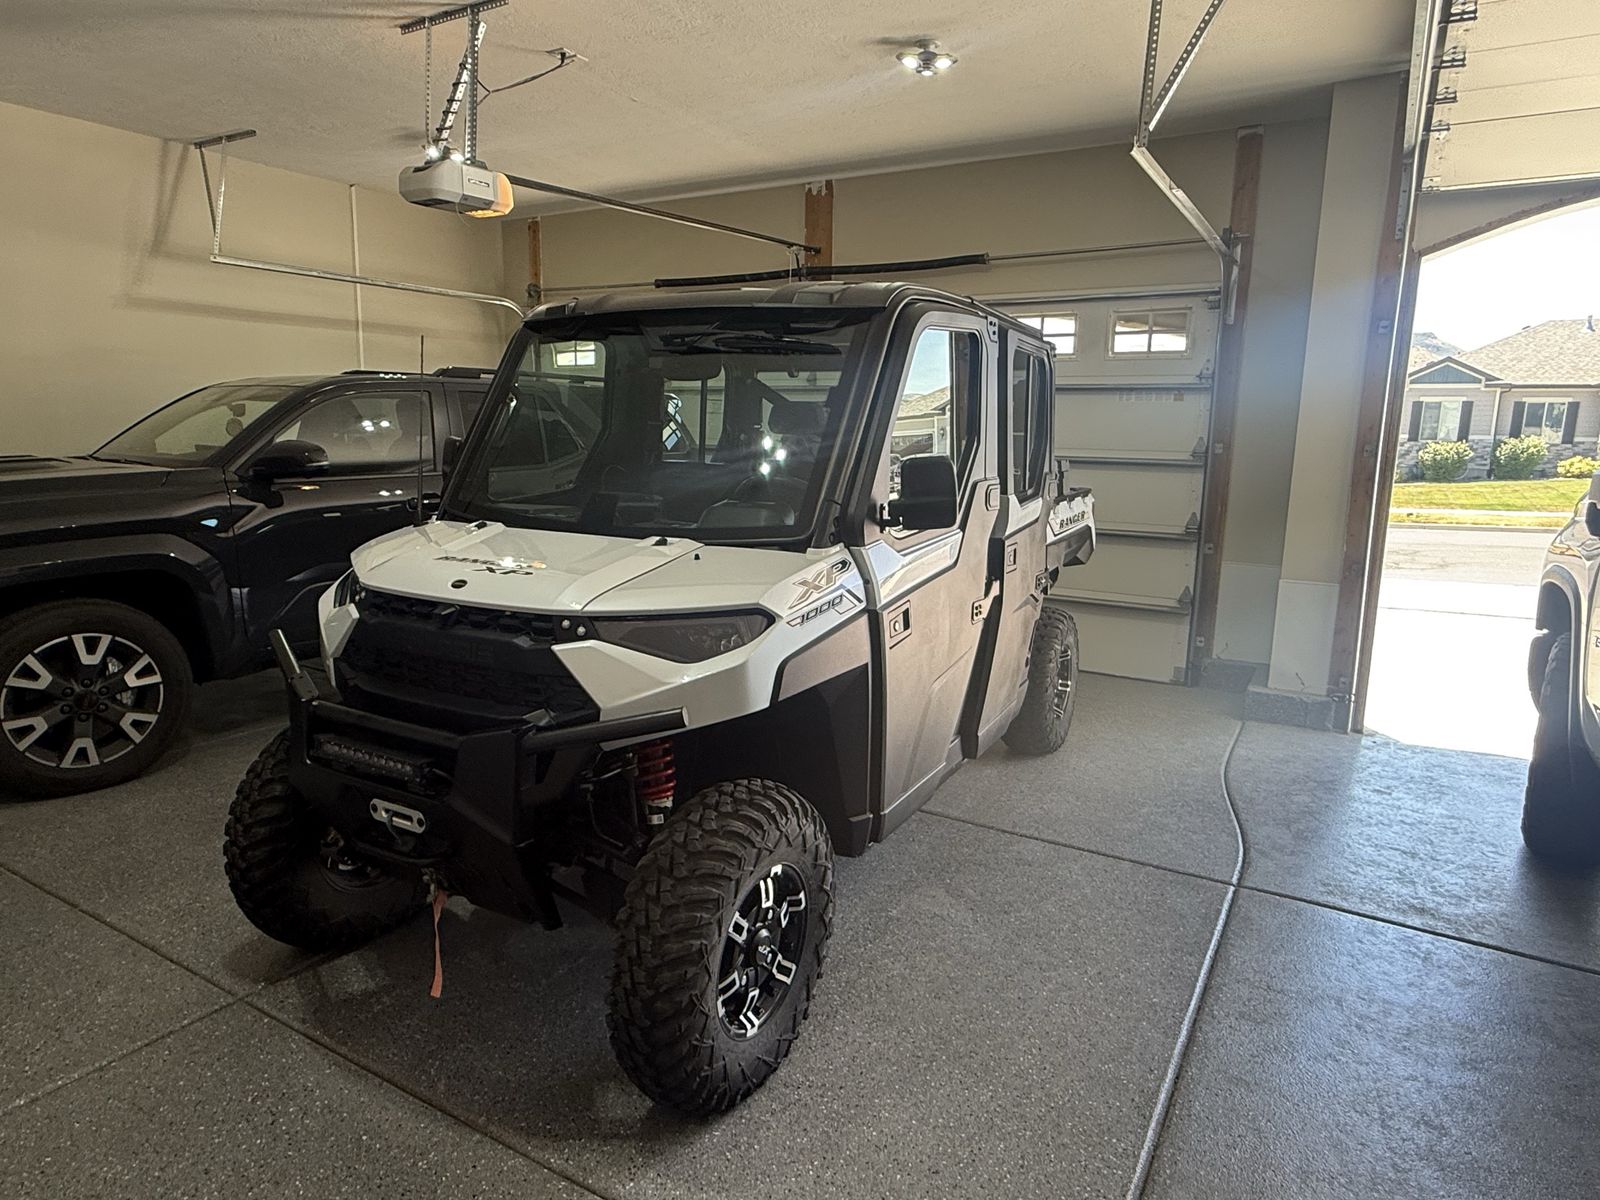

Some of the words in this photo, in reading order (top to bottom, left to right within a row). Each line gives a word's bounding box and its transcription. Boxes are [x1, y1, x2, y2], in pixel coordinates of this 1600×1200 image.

[1059, 510, 1086, 529] RANGER
[788, 557, 851, 608] XP
[797, 593, 844, 626] 1000
